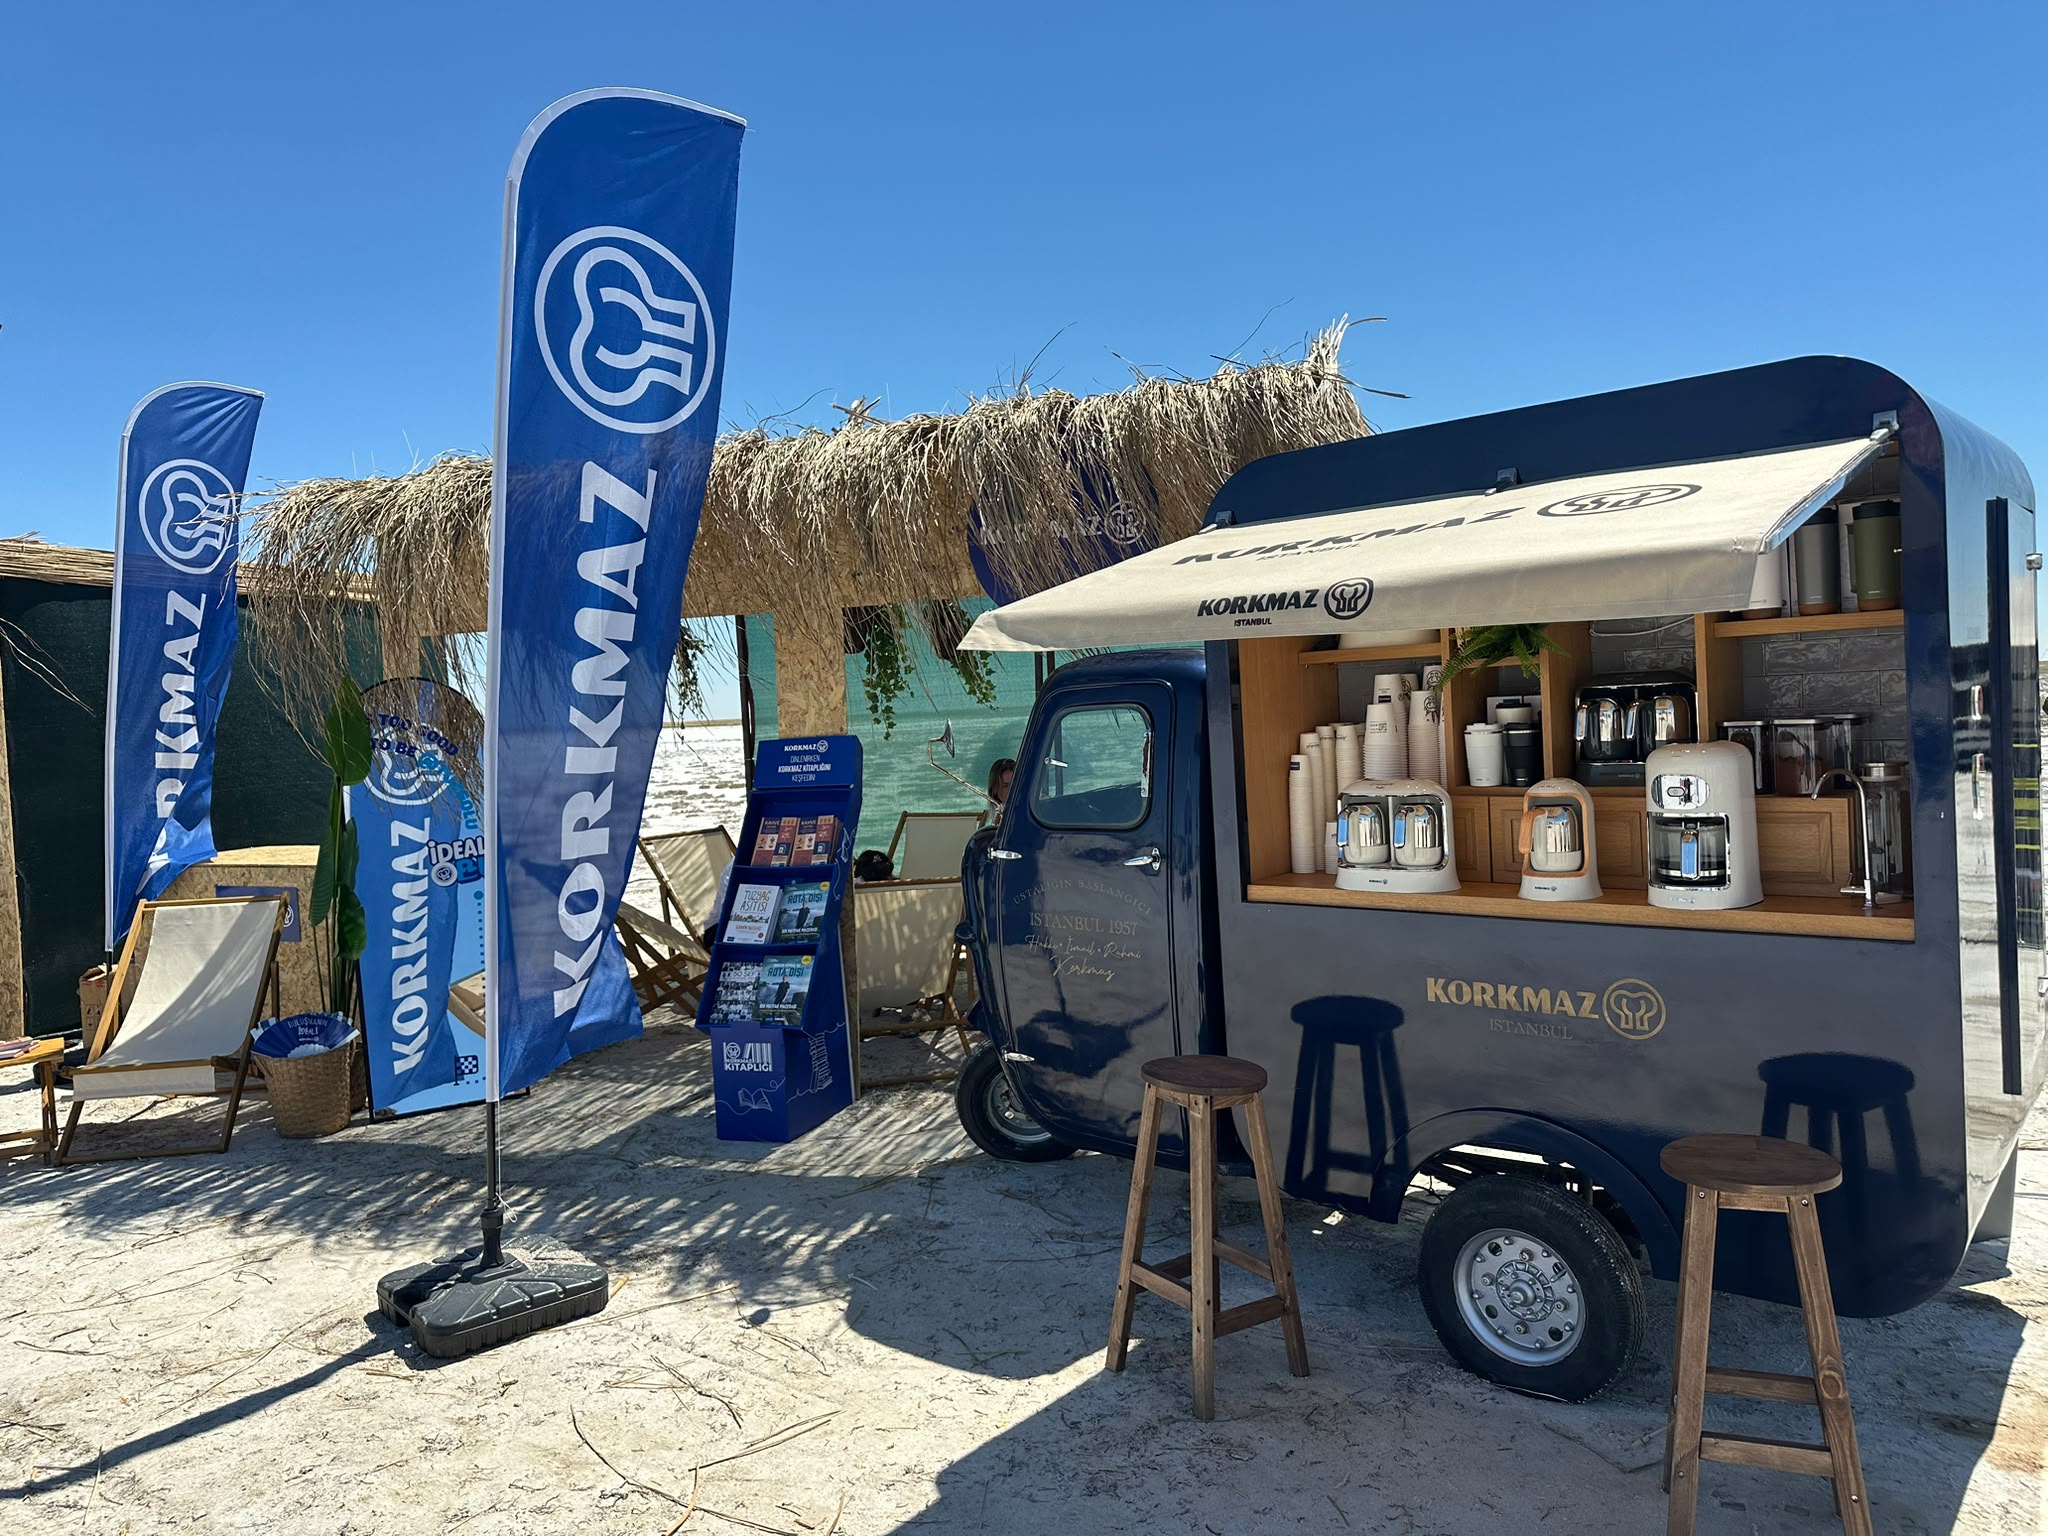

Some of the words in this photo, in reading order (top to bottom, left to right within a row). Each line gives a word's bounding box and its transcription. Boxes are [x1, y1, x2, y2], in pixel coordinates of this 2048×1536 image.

[1197, 588, 1320, 617] KORKMAZ
[1233, 617, 1273, 627] ISTANBUL
[395, 741, 419, 757] BE
[553, 460, 658, 1018] KORKMAZ
[784, 743, 817, 752] KORKMAZ
[1109, 919, 1138, 937] 1957
[391, 816, 431, 1076] KORKMAZ
[1426, 977, 1599, 1019] KORKMAZ
[1488, 1018, 1573, 1040] ISTANBUL
